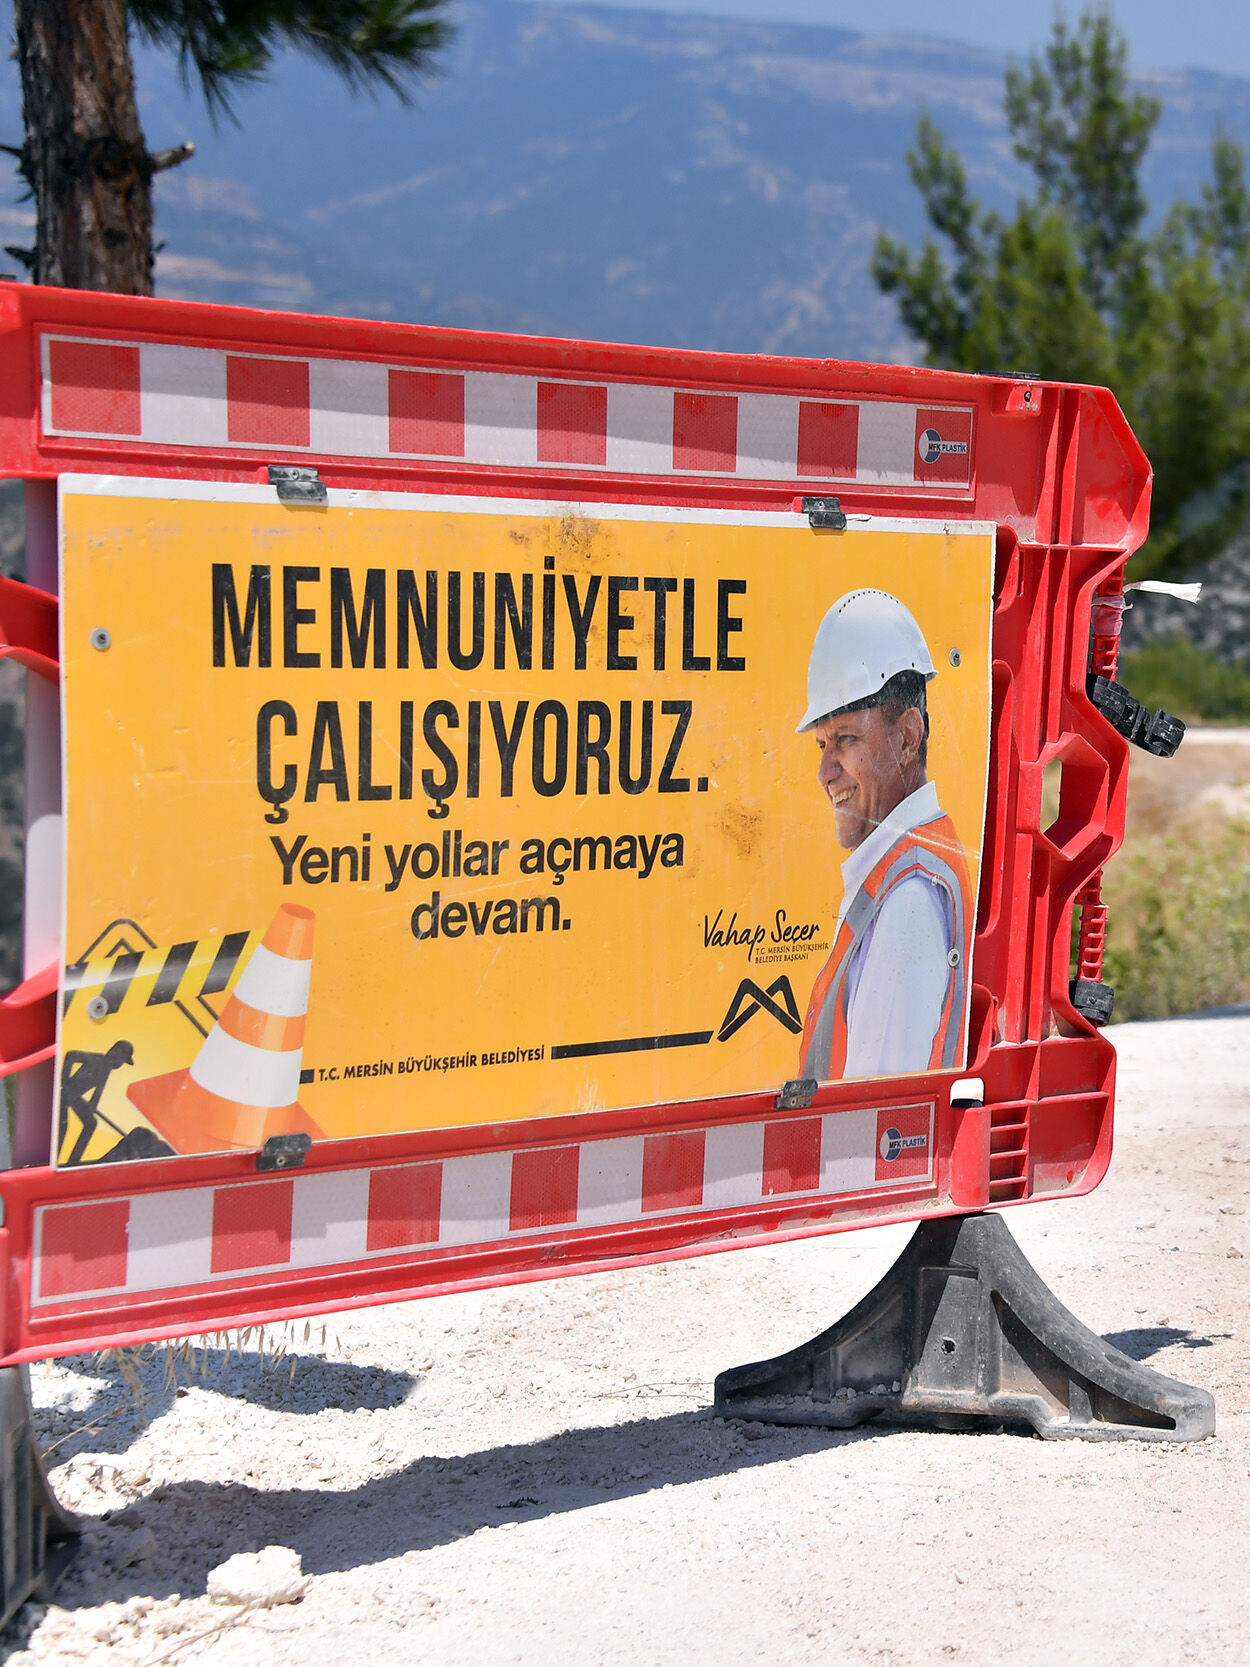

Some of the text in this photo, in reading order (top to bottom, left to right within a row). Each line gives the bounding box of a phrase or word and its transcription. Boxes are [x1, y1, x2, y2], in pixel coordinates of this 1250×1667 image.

[928, 443, 941, 452] MFK
[211, 556, 748, 671] MEMNUNİYETLE
[255, 700, 710, 824] ÇALIŞIYORUZ.
[270, 829, 685, 892] Yeni yollar açmaya
[411, 891, 572, 939] devam.
[704, 909, 820, 962] Vahap Seçer
[318, 1044, 545, 1082] T.C. MERSİN BÜYÜKŞEHİR BELEDİYESİ
[889, 1140, 901, 1149] MFK
